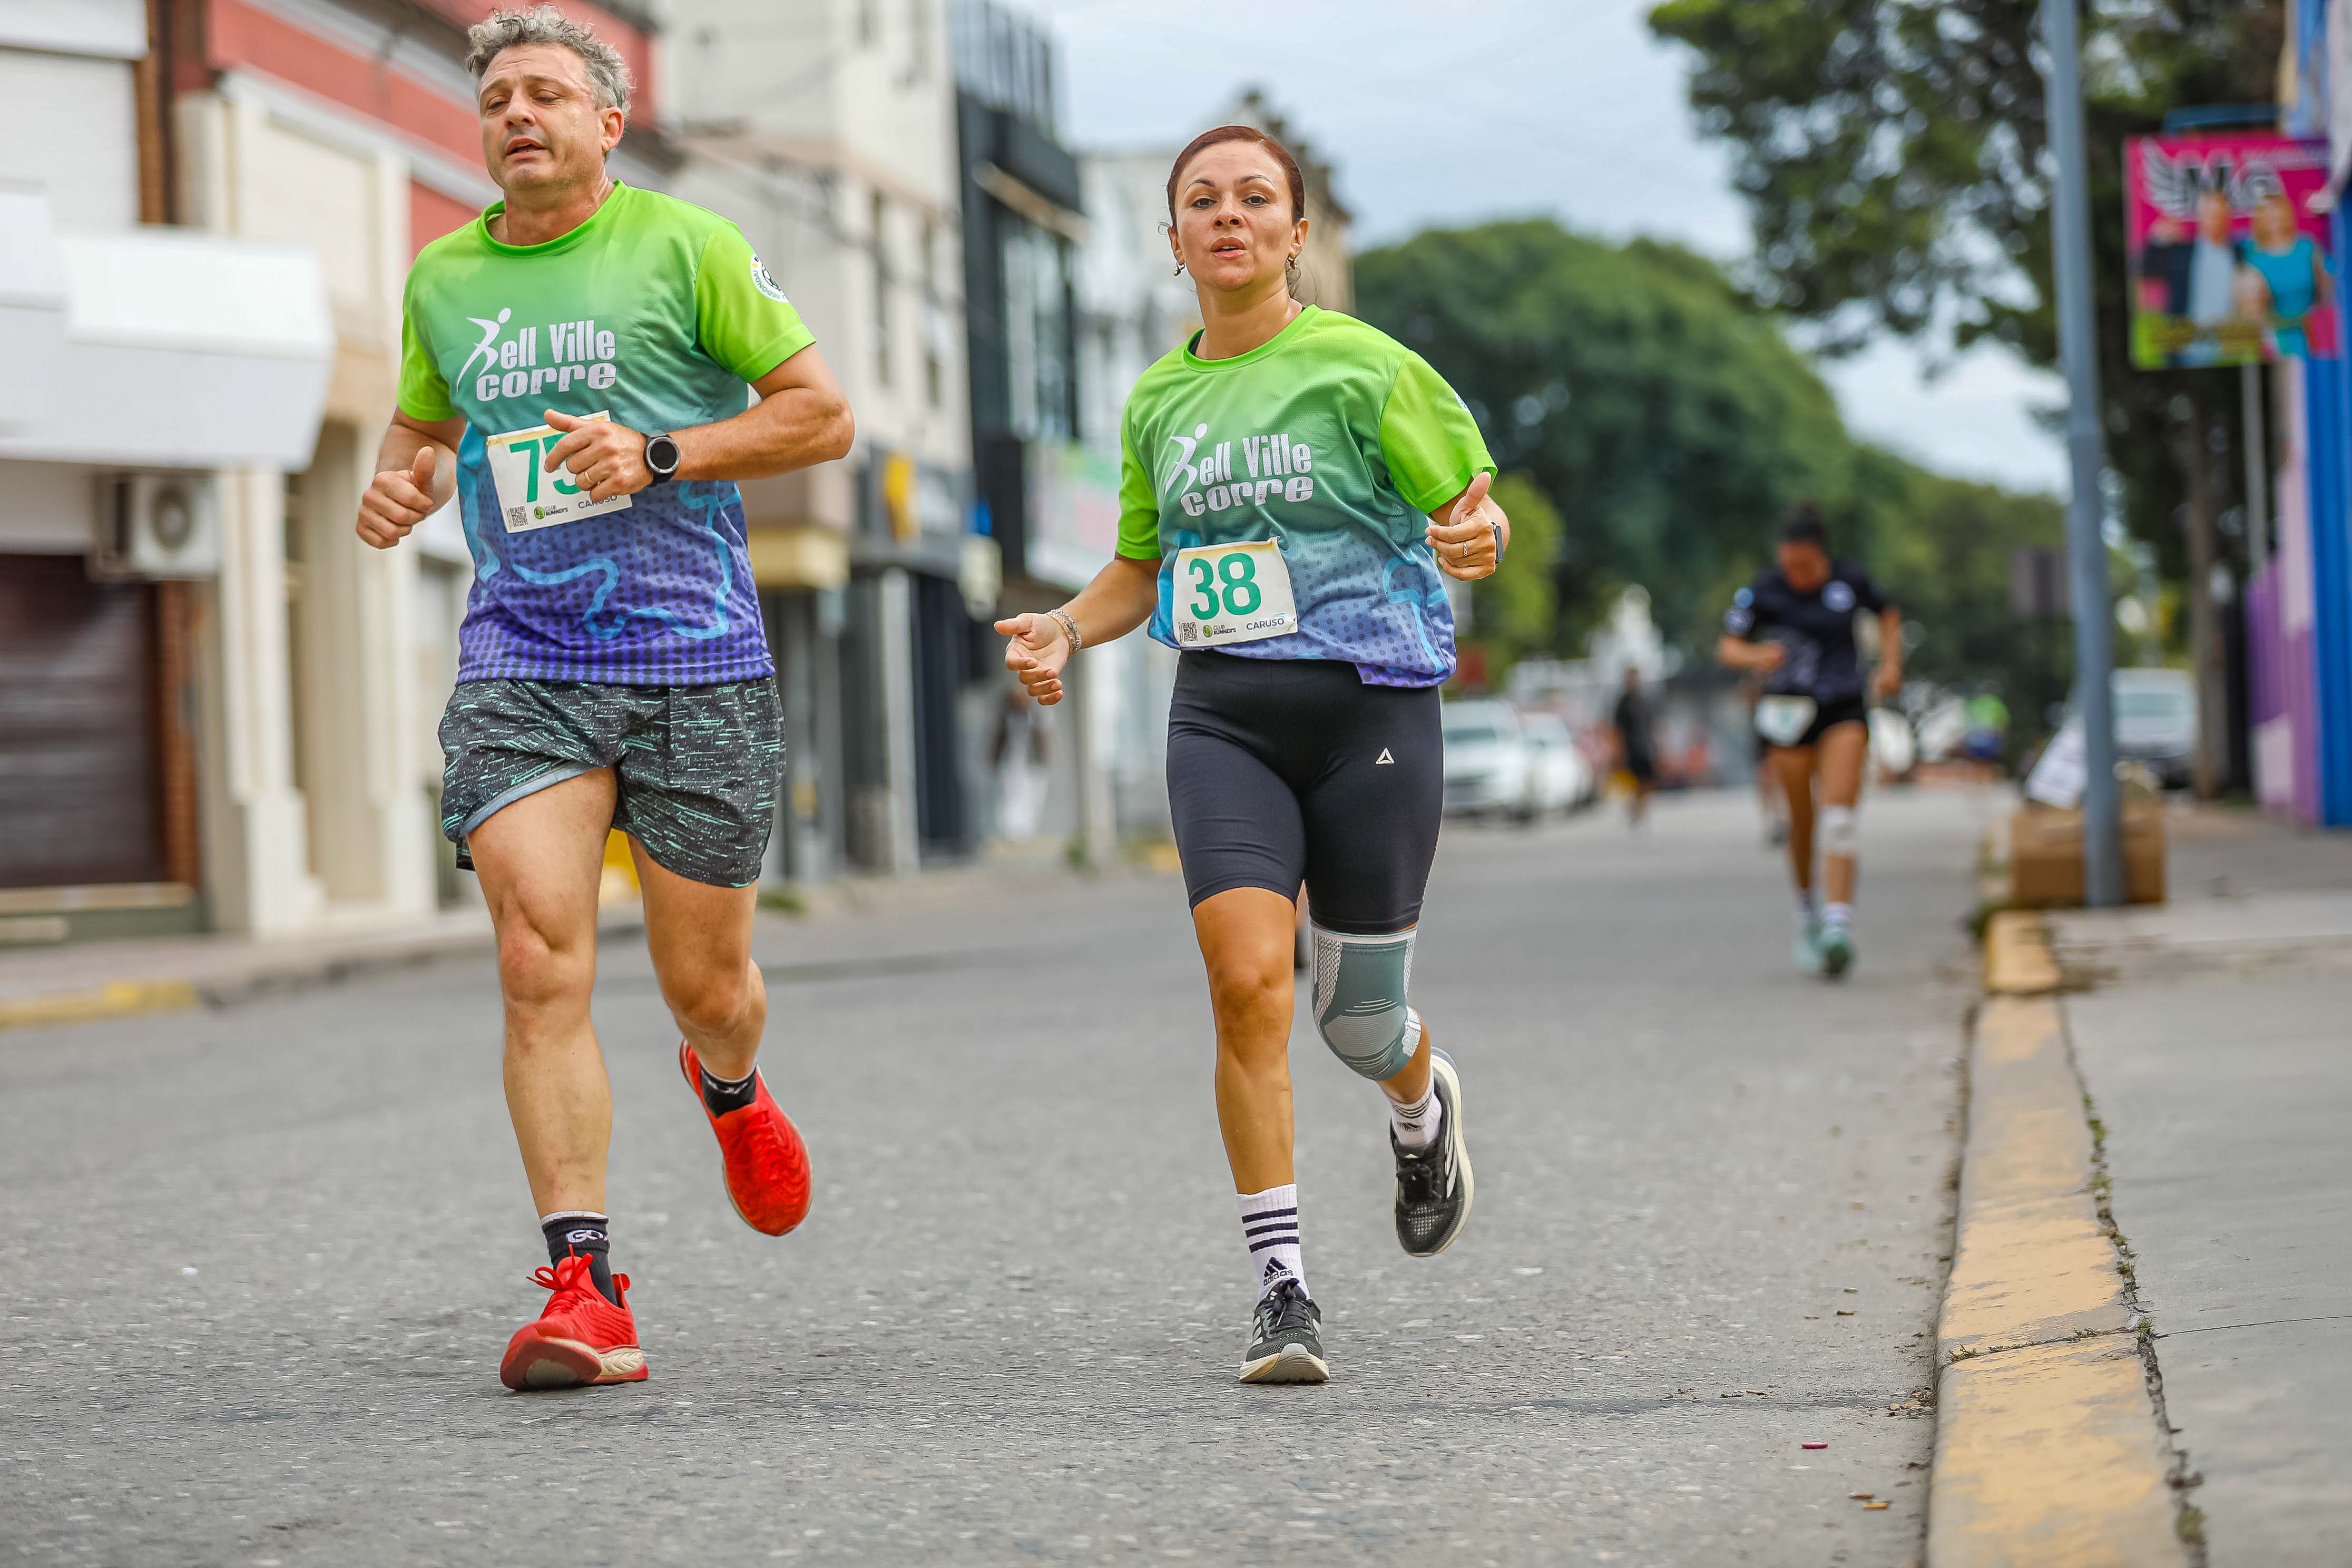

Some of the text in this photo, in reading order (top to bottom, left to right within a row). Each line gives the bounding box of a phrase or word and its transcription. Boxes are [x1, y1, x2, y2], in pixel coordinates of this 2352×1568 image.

[550, 320, 616, 364] Ville
[476, 362, 616, 401] corre
[1242, 434, 1312, 478] Ville
[1181, 476, 1314, 516] corre
[1188, 553, 1262, 620] 38
[1246, 618, 1285, 630] CARUSO
[1263, 1270, 1293, 1287] adidas
